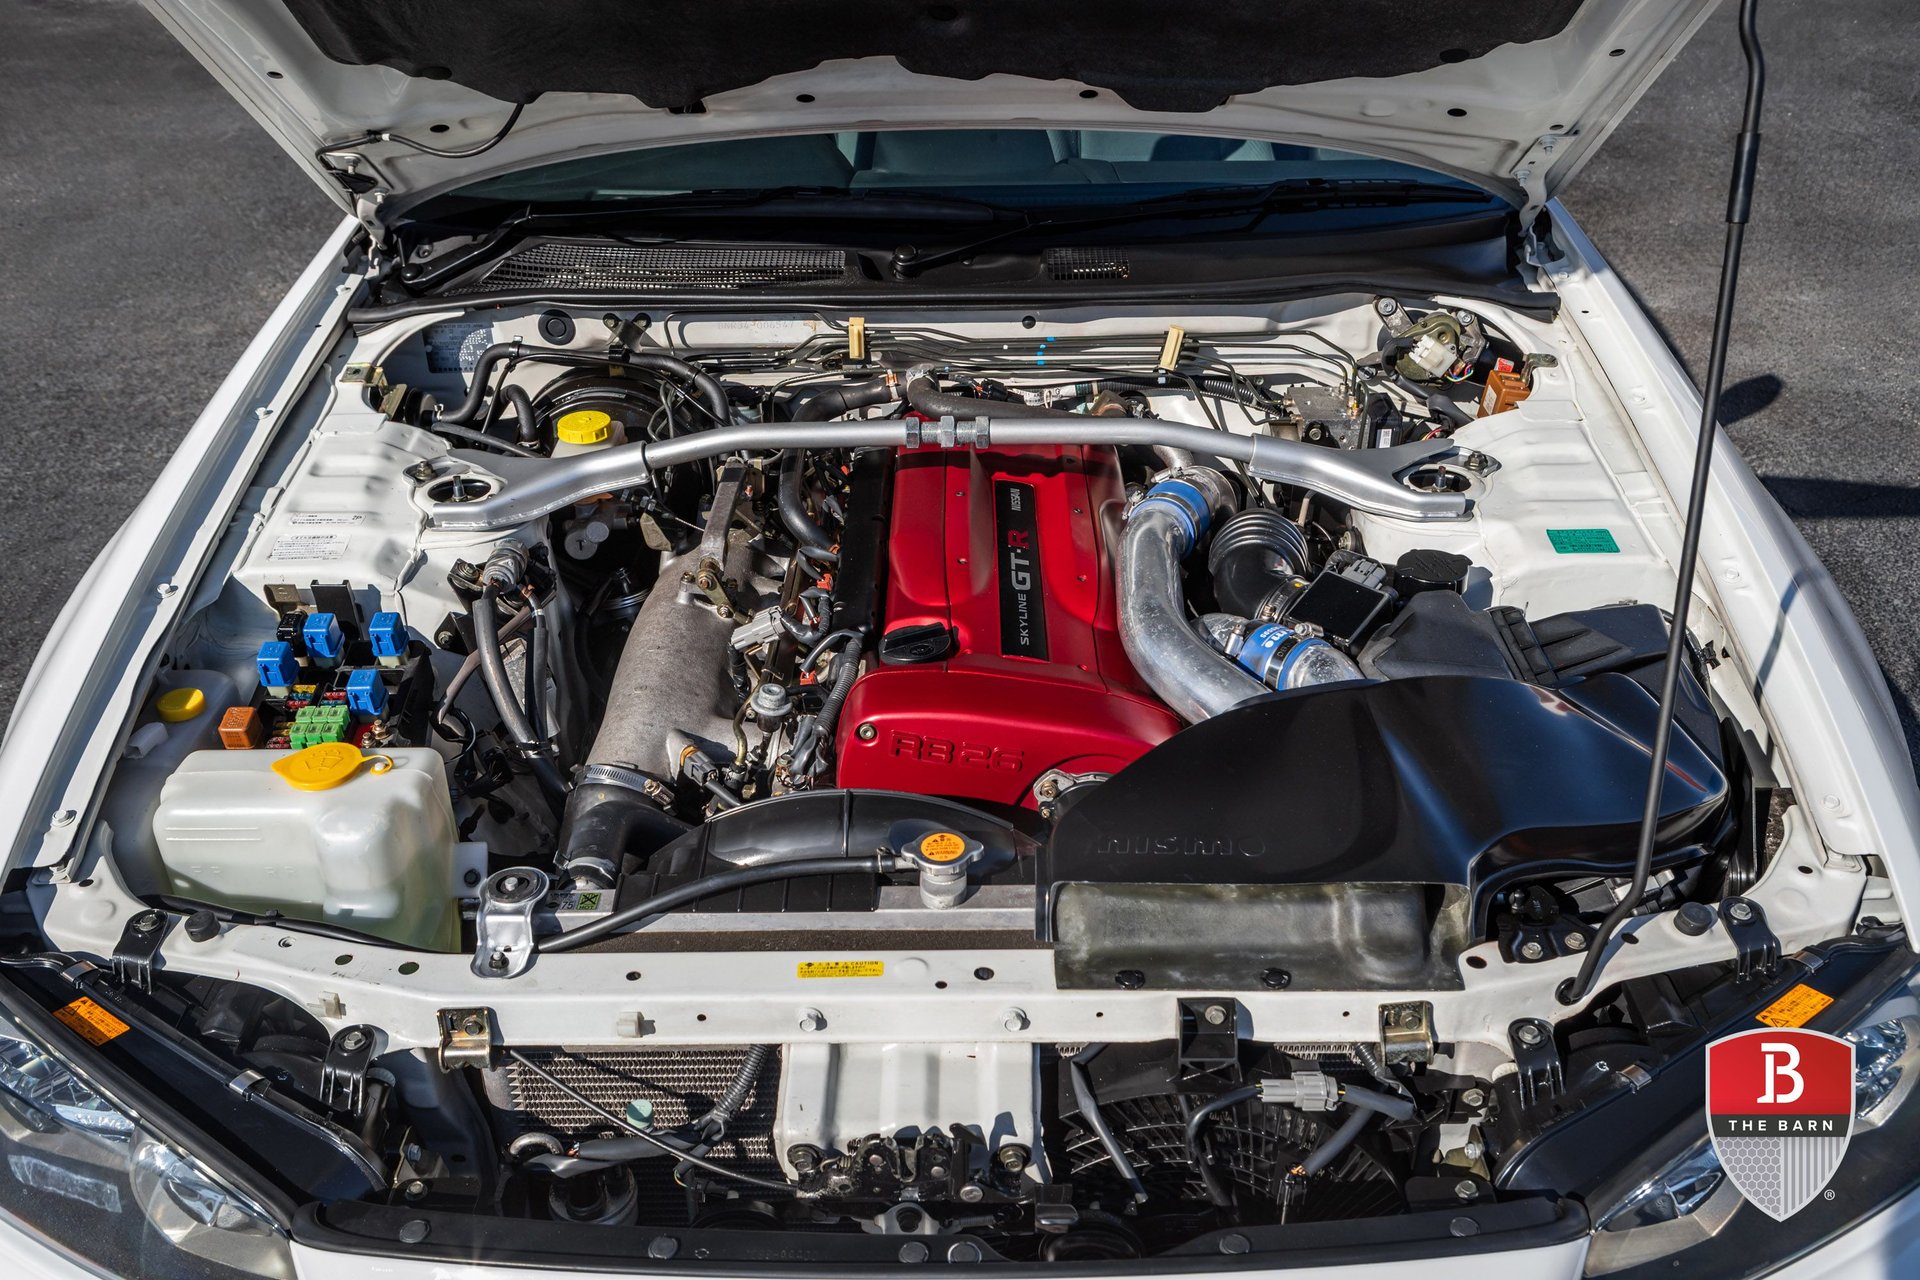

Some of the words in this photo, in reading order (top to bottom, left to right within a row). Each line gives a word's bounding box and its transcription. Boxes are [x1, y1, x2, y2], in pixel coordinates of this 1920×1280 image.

[1010, 487, 1022, 512] NISSAN
[1018, 592, 1030, 646] SKYLINE
[561, 901, 574, 910] 75
